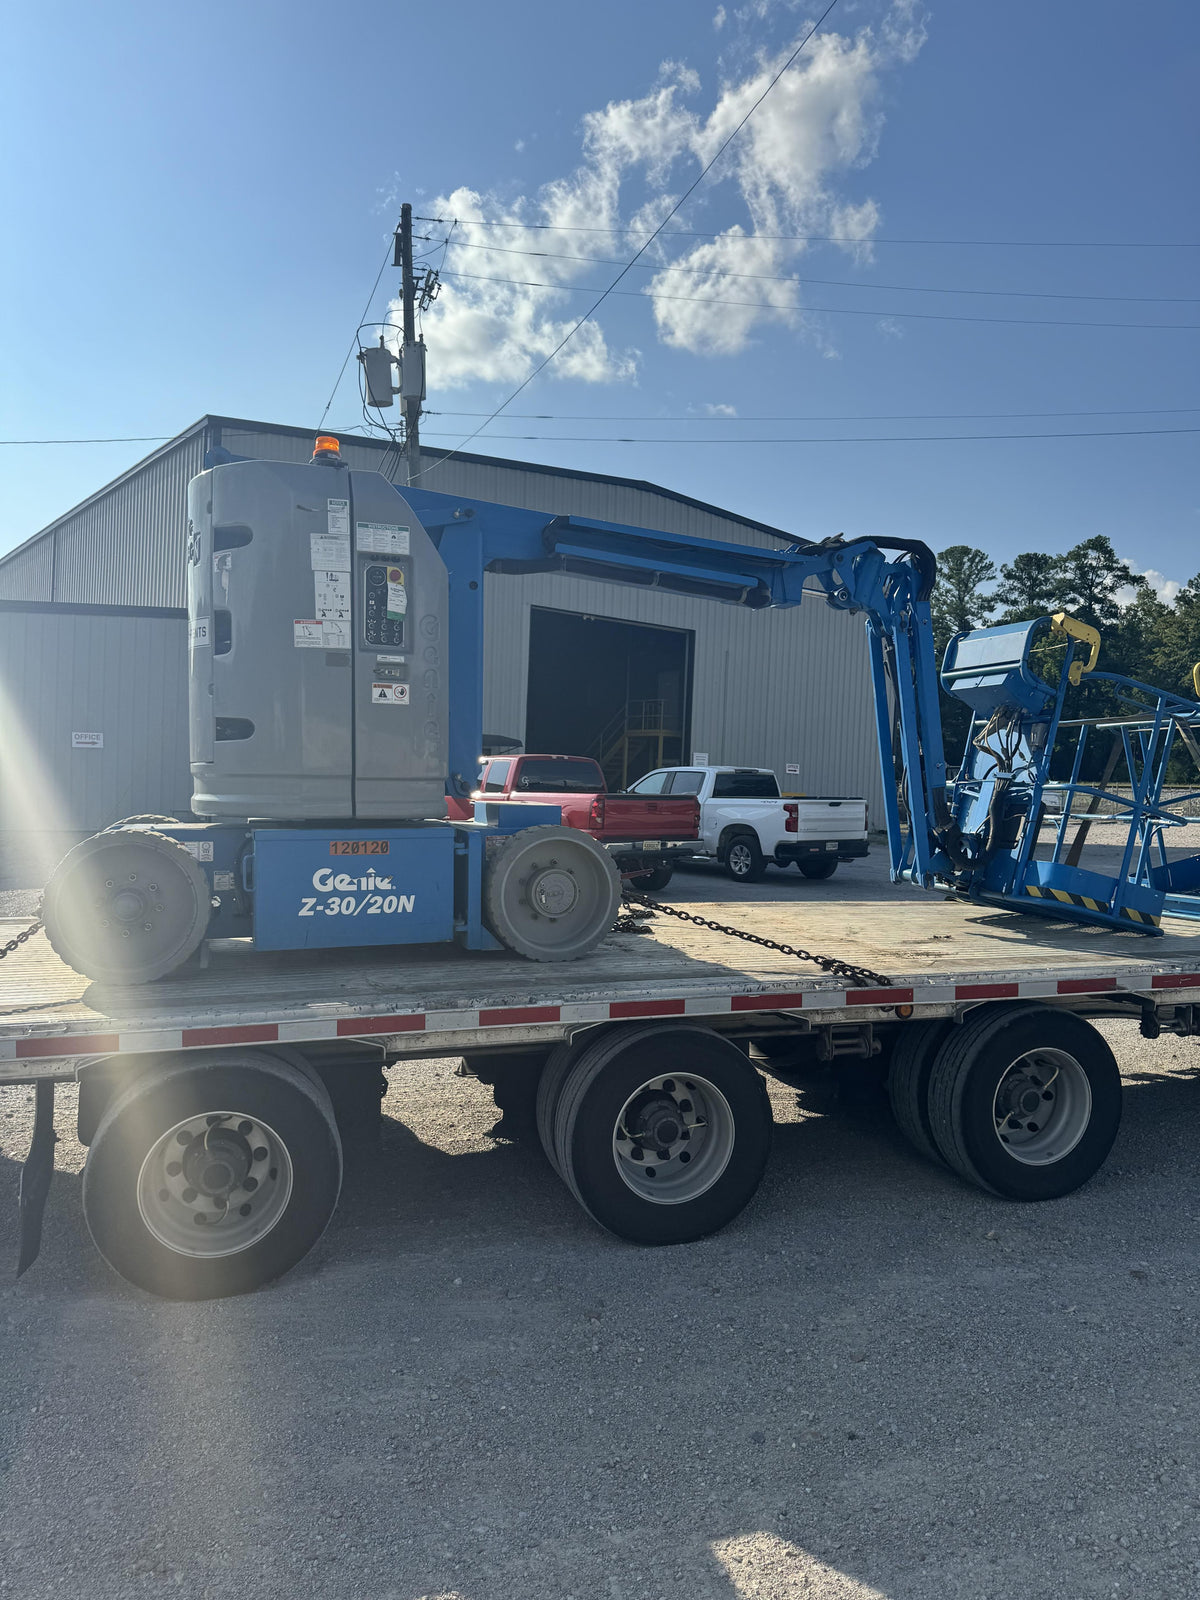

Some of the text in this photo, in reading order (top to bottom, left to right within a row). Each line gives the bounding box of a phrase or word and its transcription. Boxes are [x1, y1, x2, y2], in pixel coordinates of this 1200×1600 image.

[74, 733, 101, 741] OFFICE
[331, 841, 389, 855] 120120
[312, 867, 394, 892] Genie
[298, 894, 416, 916] Z-30/20N
